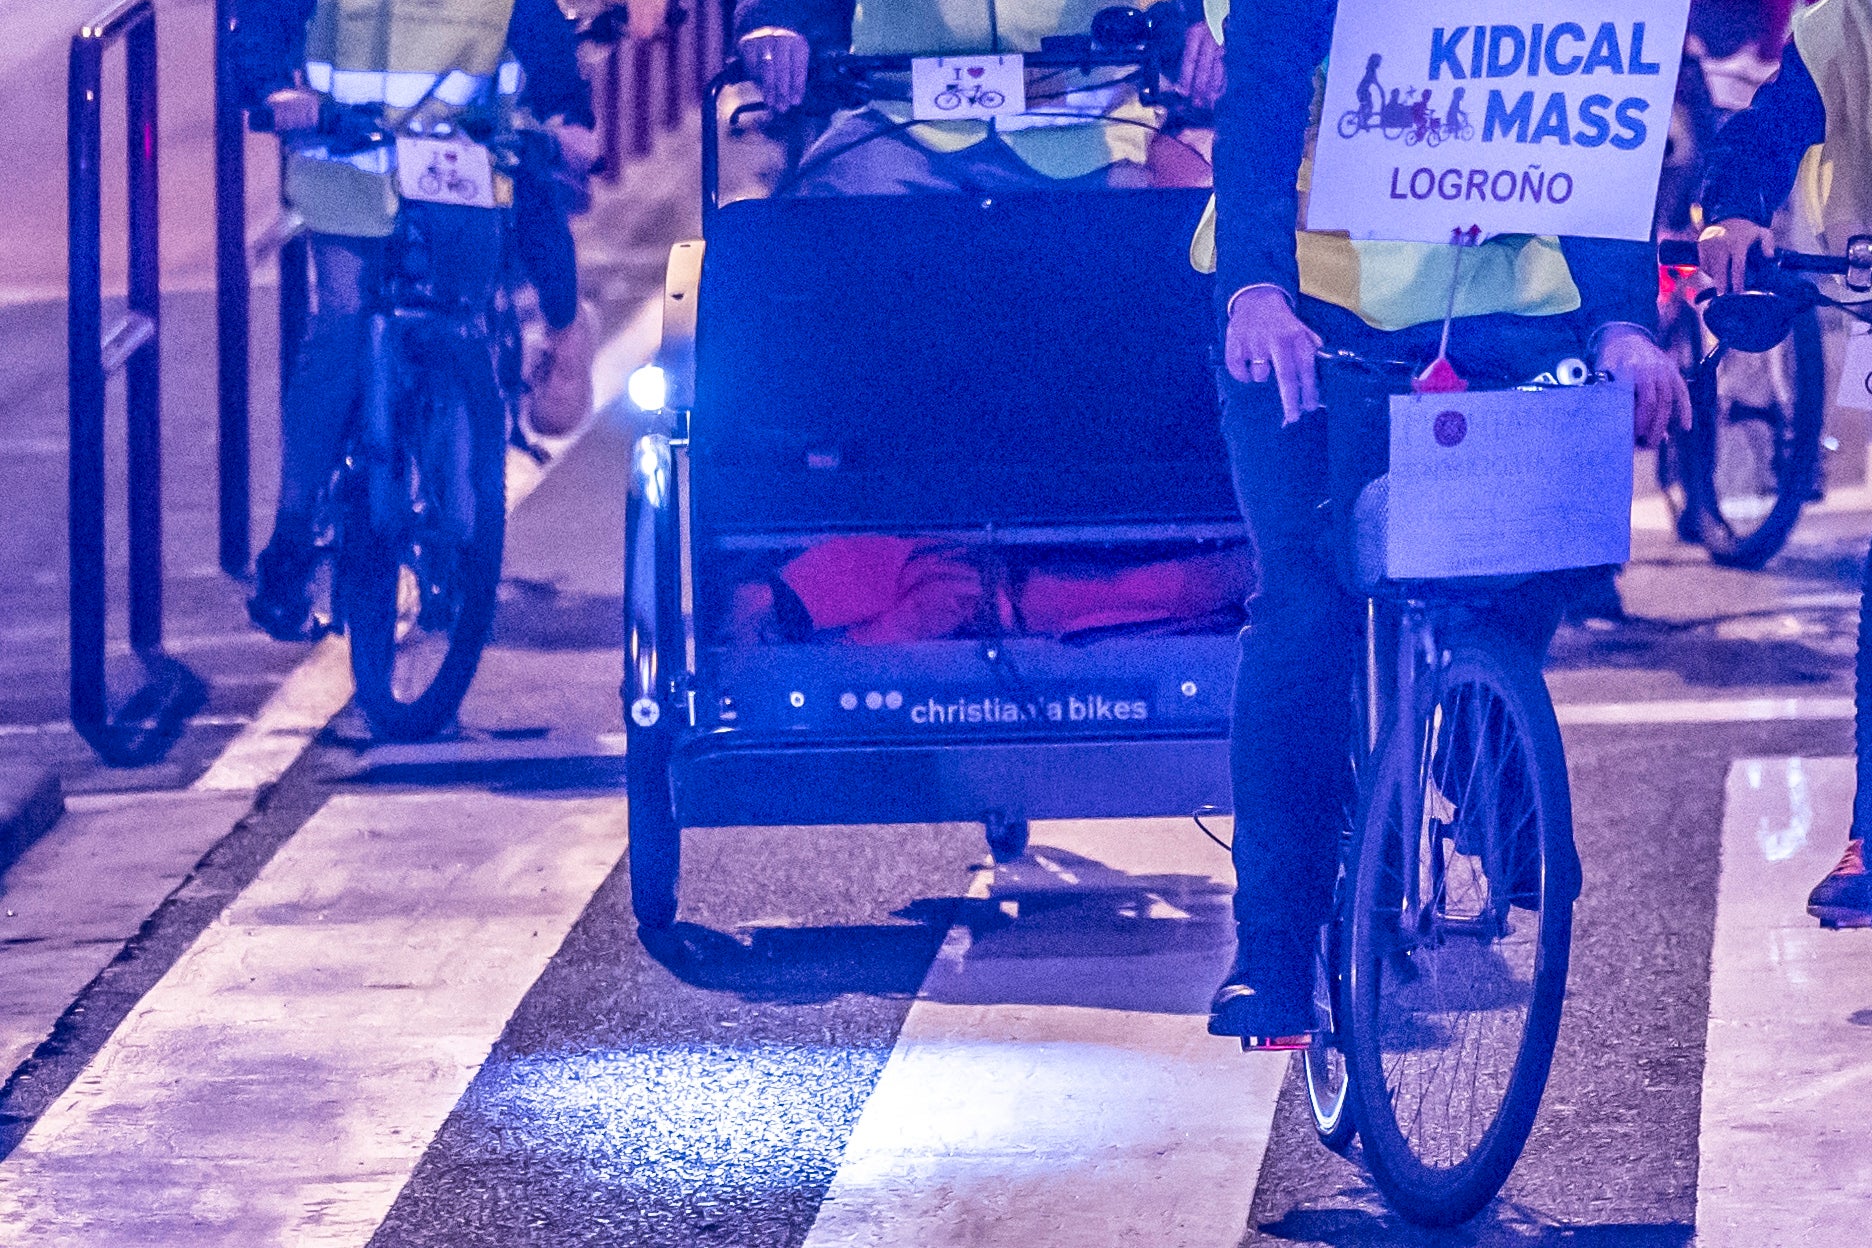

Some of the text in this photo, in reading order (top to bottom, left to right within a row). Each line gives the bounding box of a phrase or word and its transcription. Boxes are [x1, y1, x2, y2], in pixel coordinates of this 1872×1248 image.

[1428, 21, 1661, 81] KIDICAL
[1481, 89, 1650, 150] MASS
[1390, 165, 1573, 204] LOGROÑO
[1068, 695, 1147, 721] bikes
